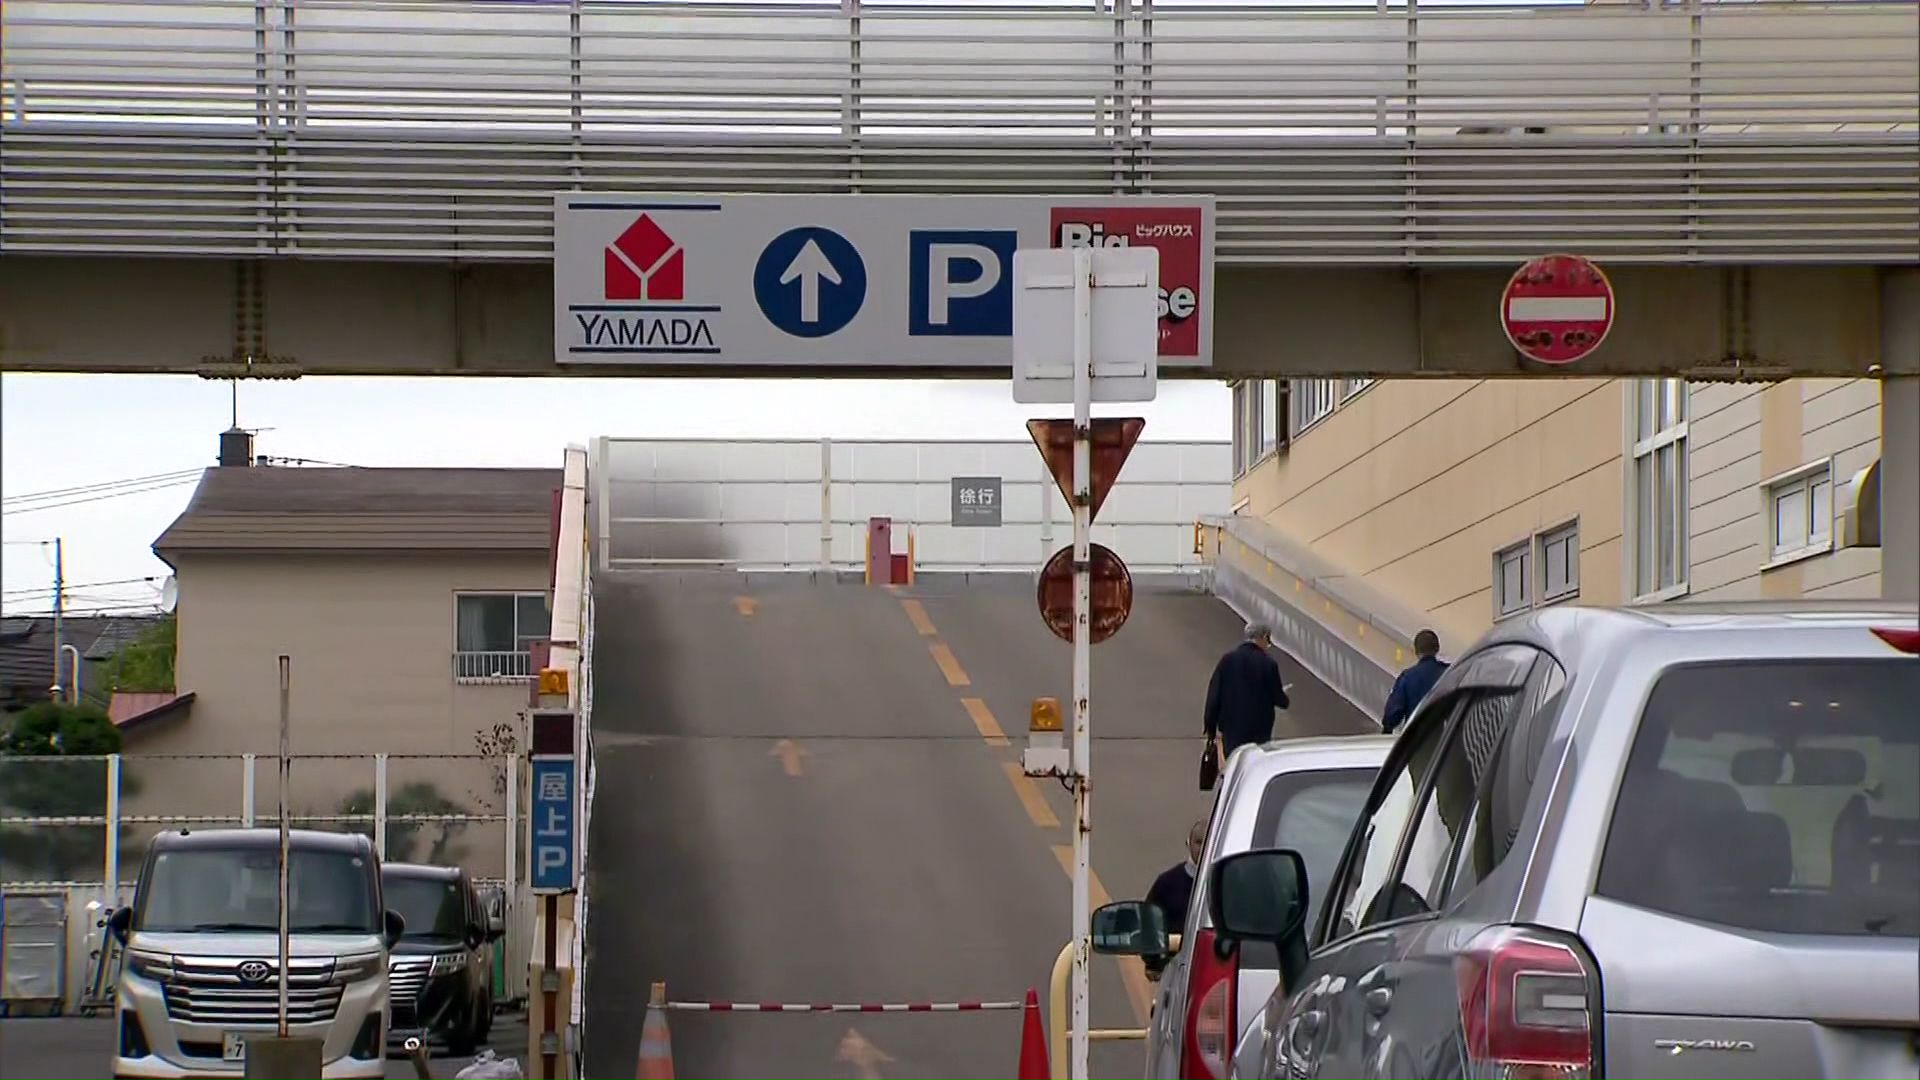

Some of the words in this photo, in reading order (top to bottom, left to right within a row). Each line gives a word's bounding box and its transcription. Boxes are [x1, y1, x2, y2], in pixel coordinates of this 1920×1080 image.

[1135, 224, 1193, 237] ビッグハウス
[928, 243, 1001, 325] P
[576, 314, 714, 346] YAMADA
[960, 488, 994, 504] 徐行
[538, 772, 567, 877] 屋上P
